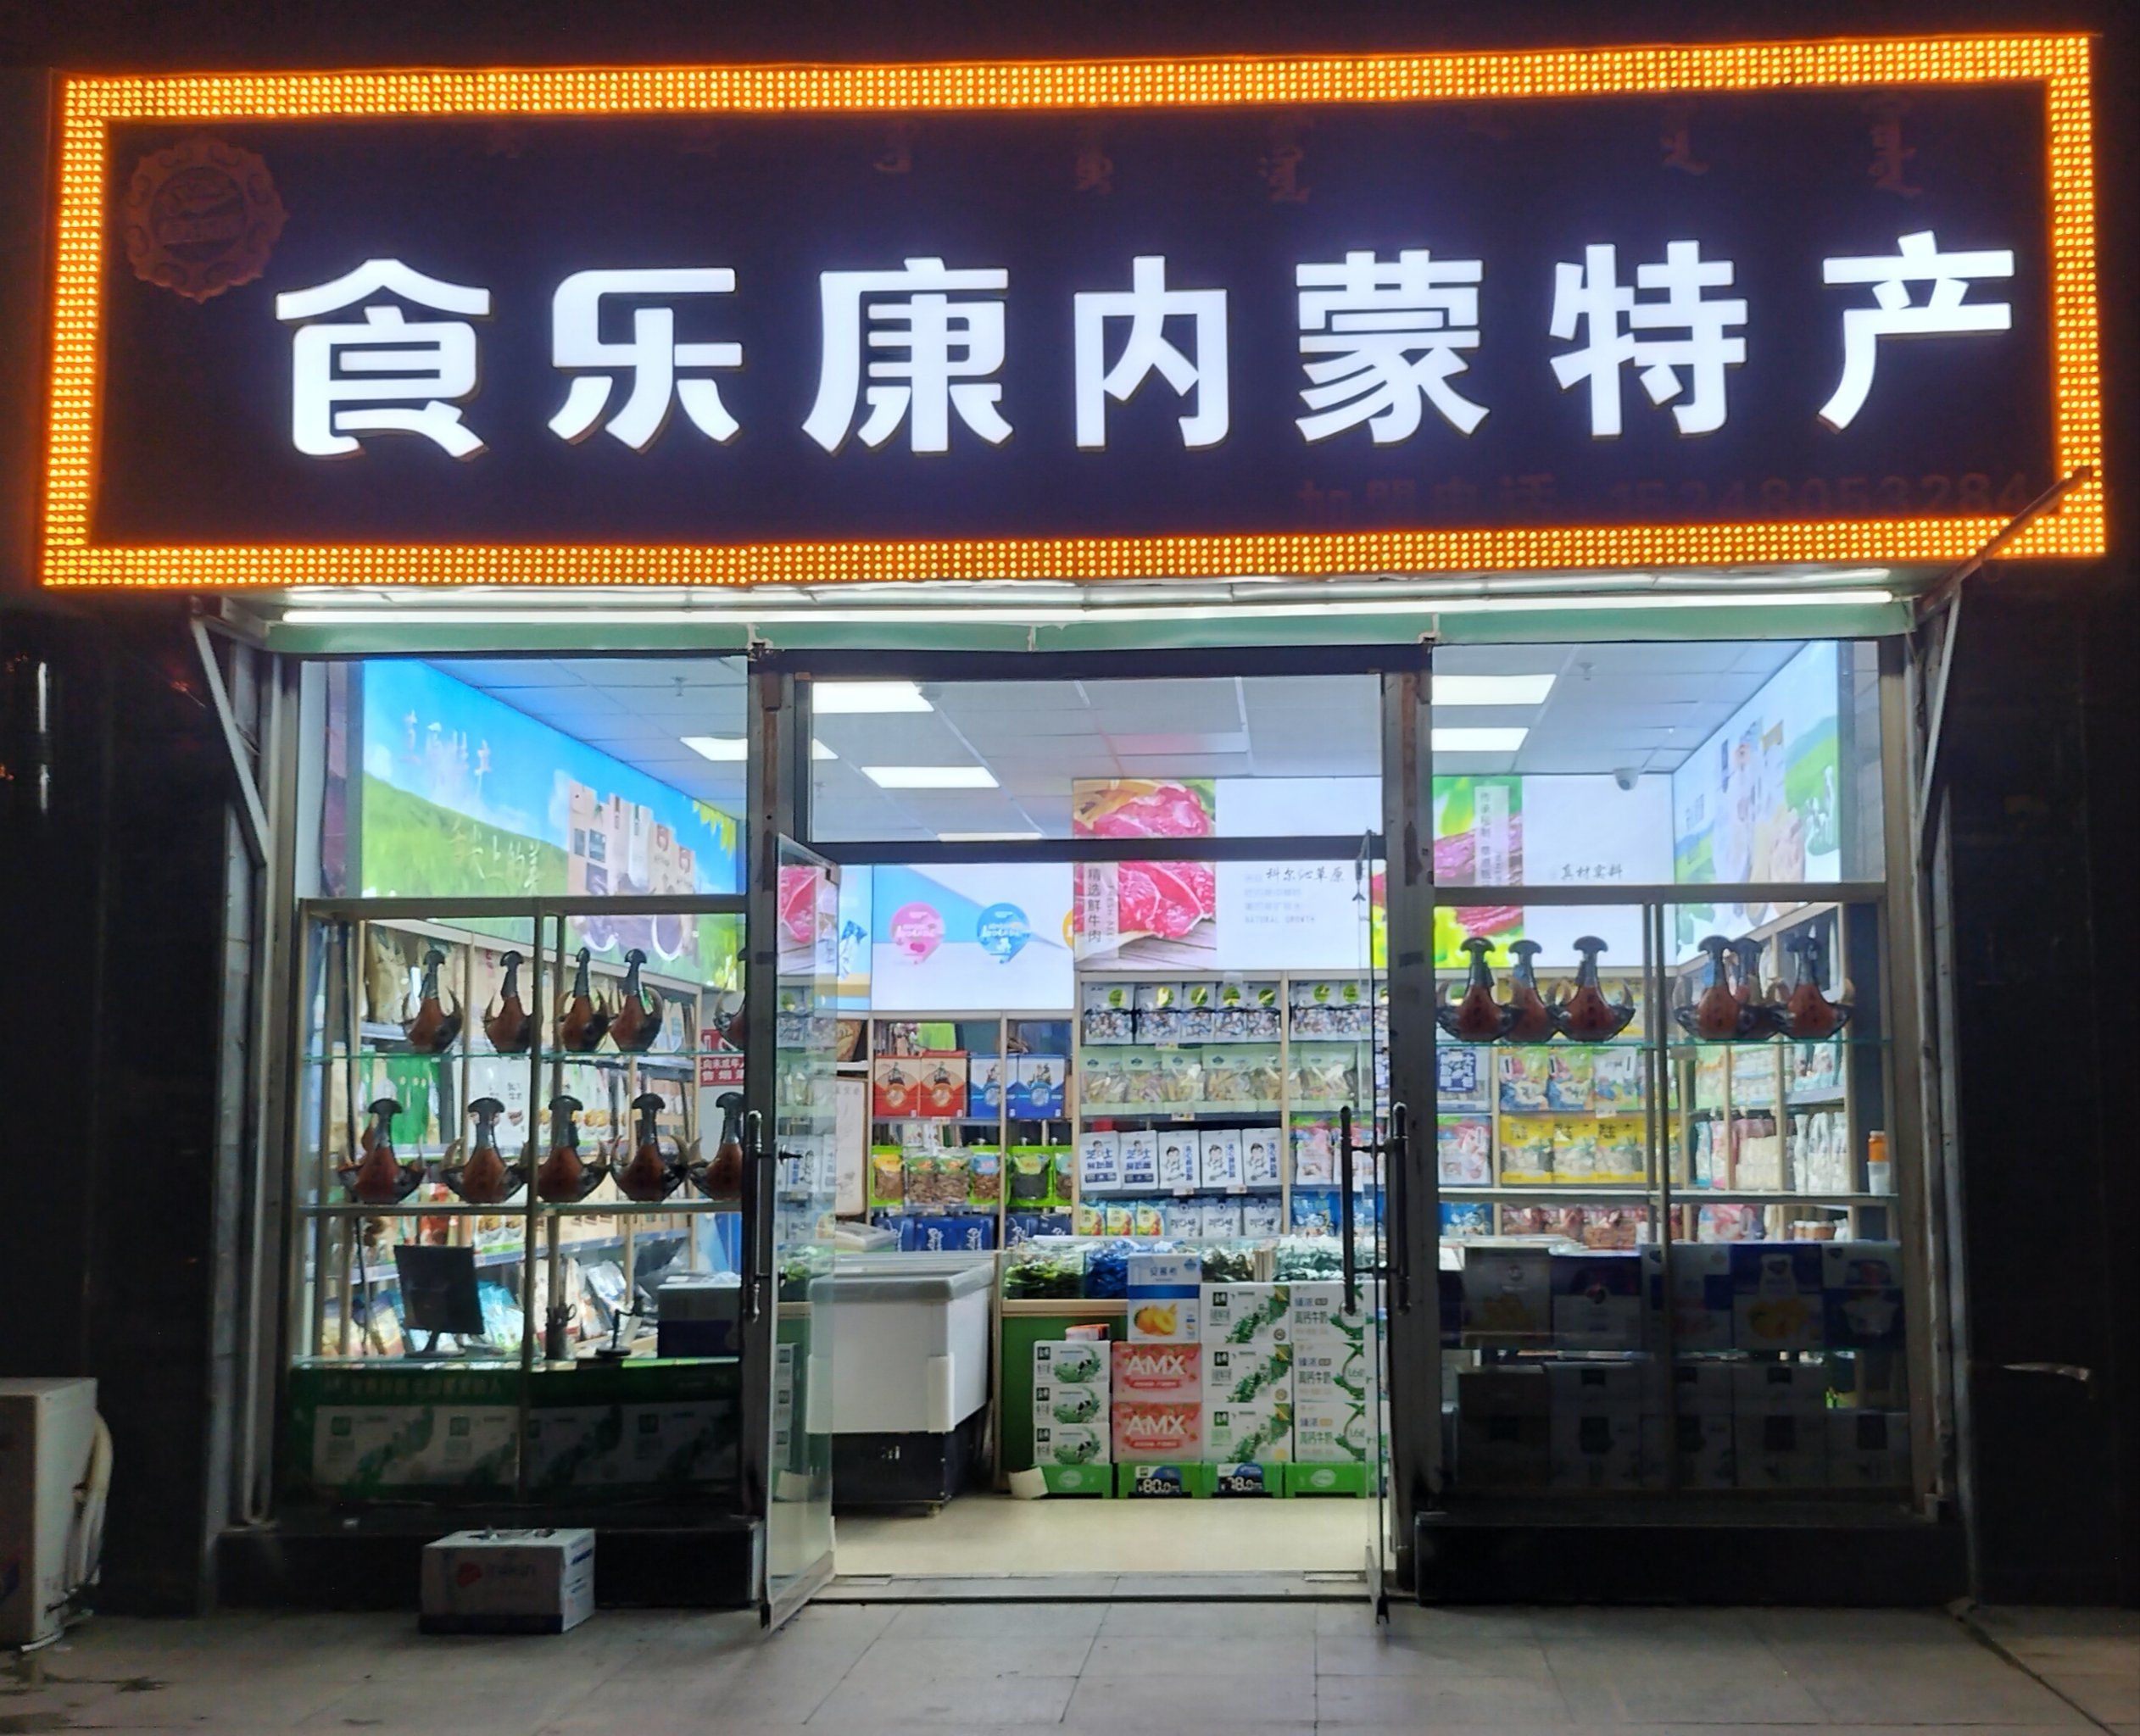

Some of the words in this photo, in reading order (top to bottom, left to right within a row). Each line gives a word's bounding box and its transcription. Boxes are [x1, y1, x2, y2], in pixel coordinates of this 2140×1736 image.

[276, 230, 2015, 459] 食乐康内蒙特产
[1561, 864, 1624, 880] 真材实料
[1088, 868, 1101, 943] 精选鲜牛肉
[1126, 1355, 1185, 1375] AMX
[1125, 1415, 1185, 1435] AMX
